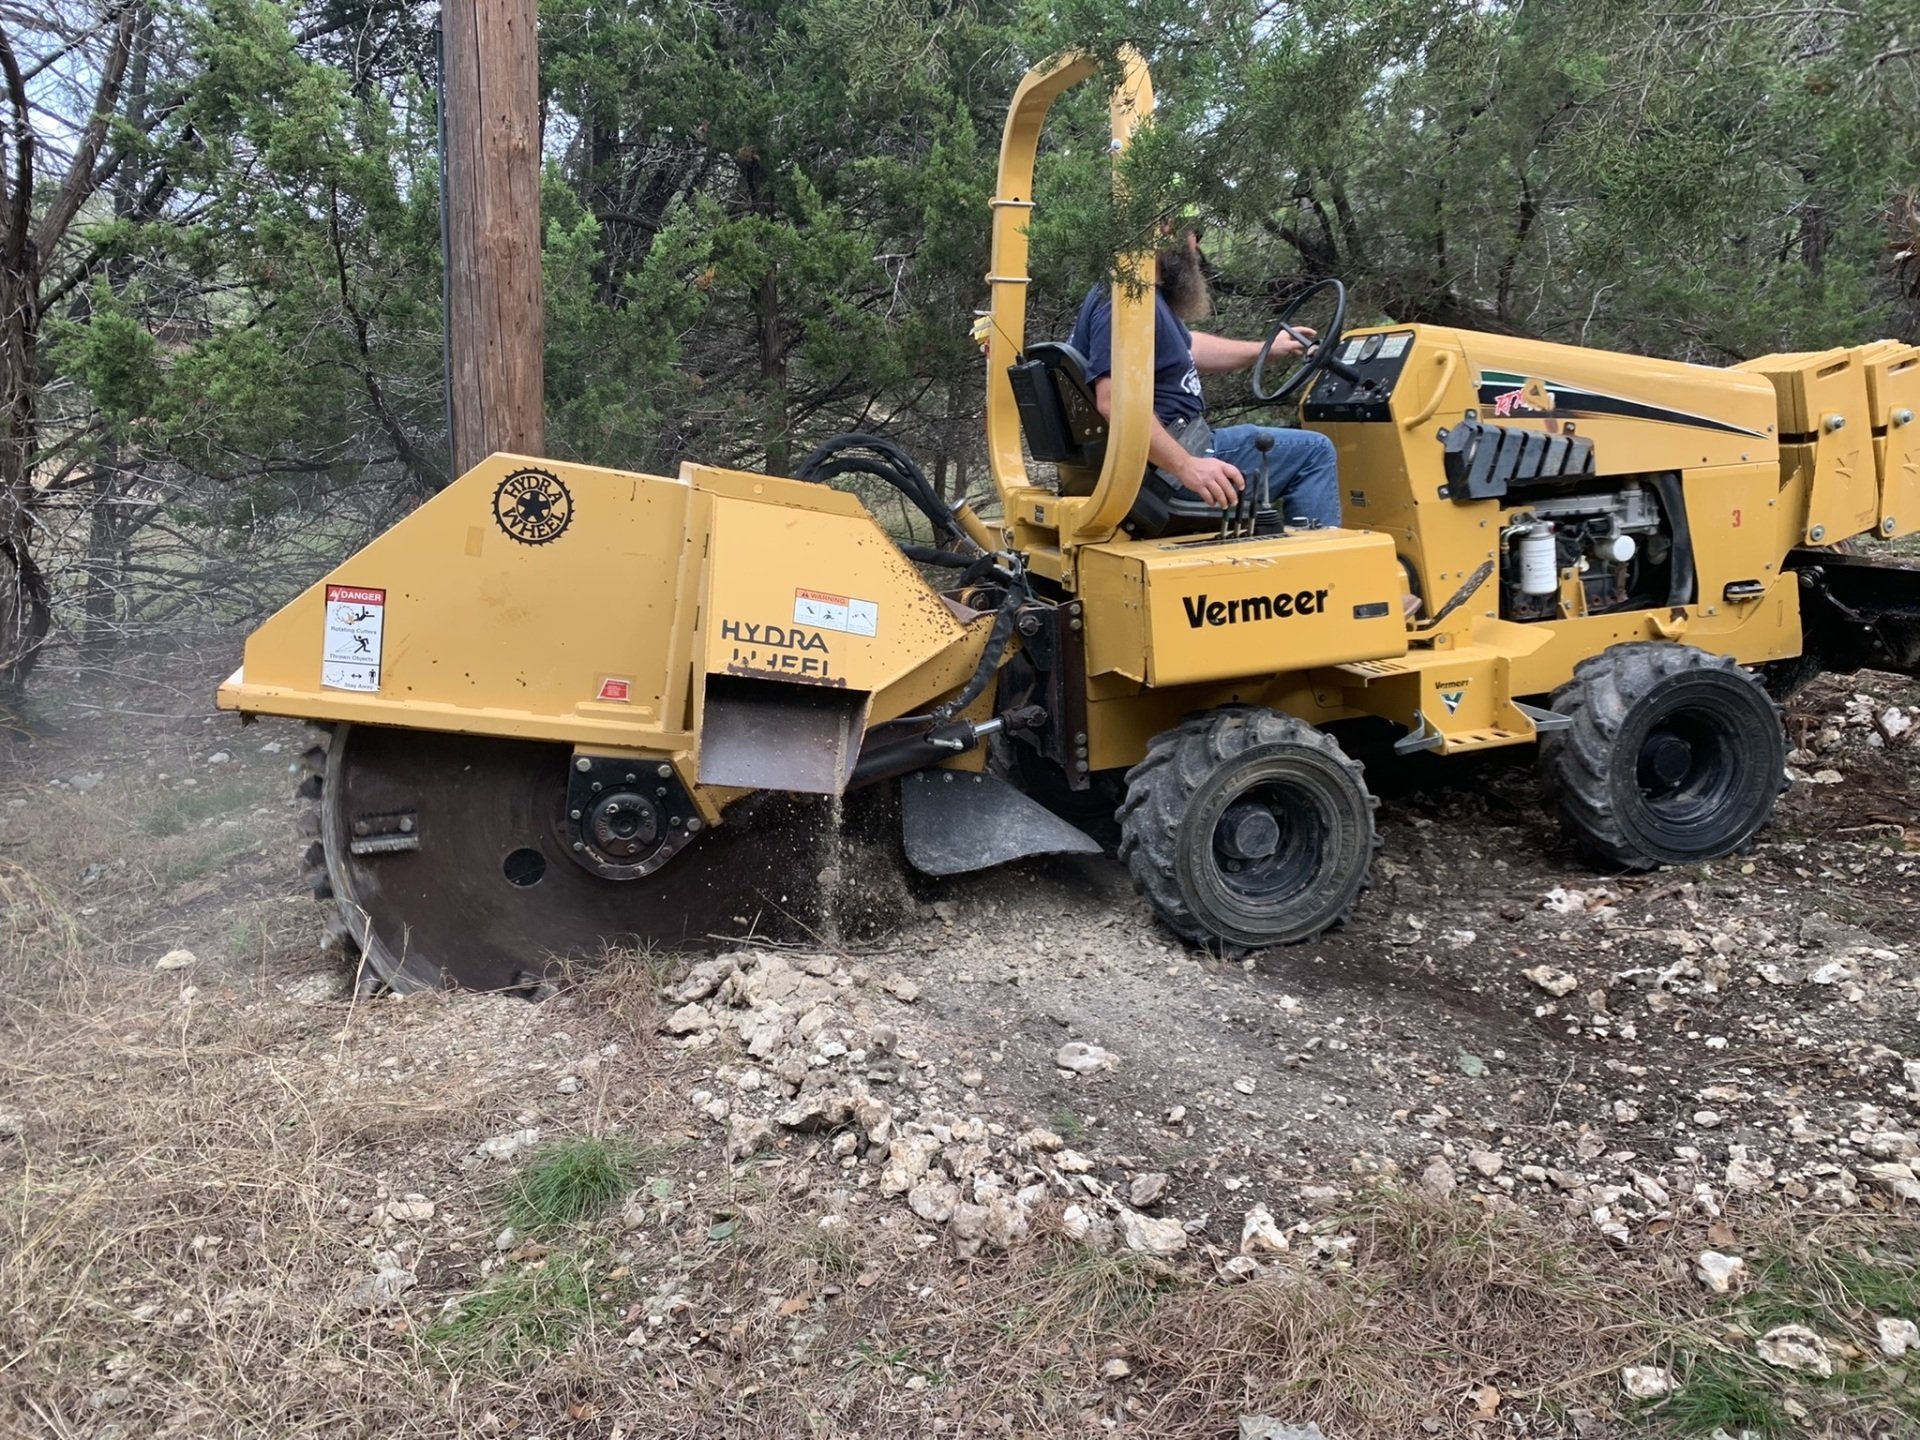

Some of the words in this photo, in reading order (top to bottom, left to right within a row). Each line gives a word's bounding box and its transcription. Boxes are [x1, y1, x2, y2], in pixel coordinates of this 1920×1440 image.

[503, 475, 564, 507] HYDRA
[501, 506, 566, 539] WHEEL
[1731, 508, 1741, 528] 3
[340, 590, 382, 602] DANGER
[810, 592, 846, 605] WARNING
[1182, 588, 1329, 629] Vermeer
[721, 618, 829, 654] HYDRA
